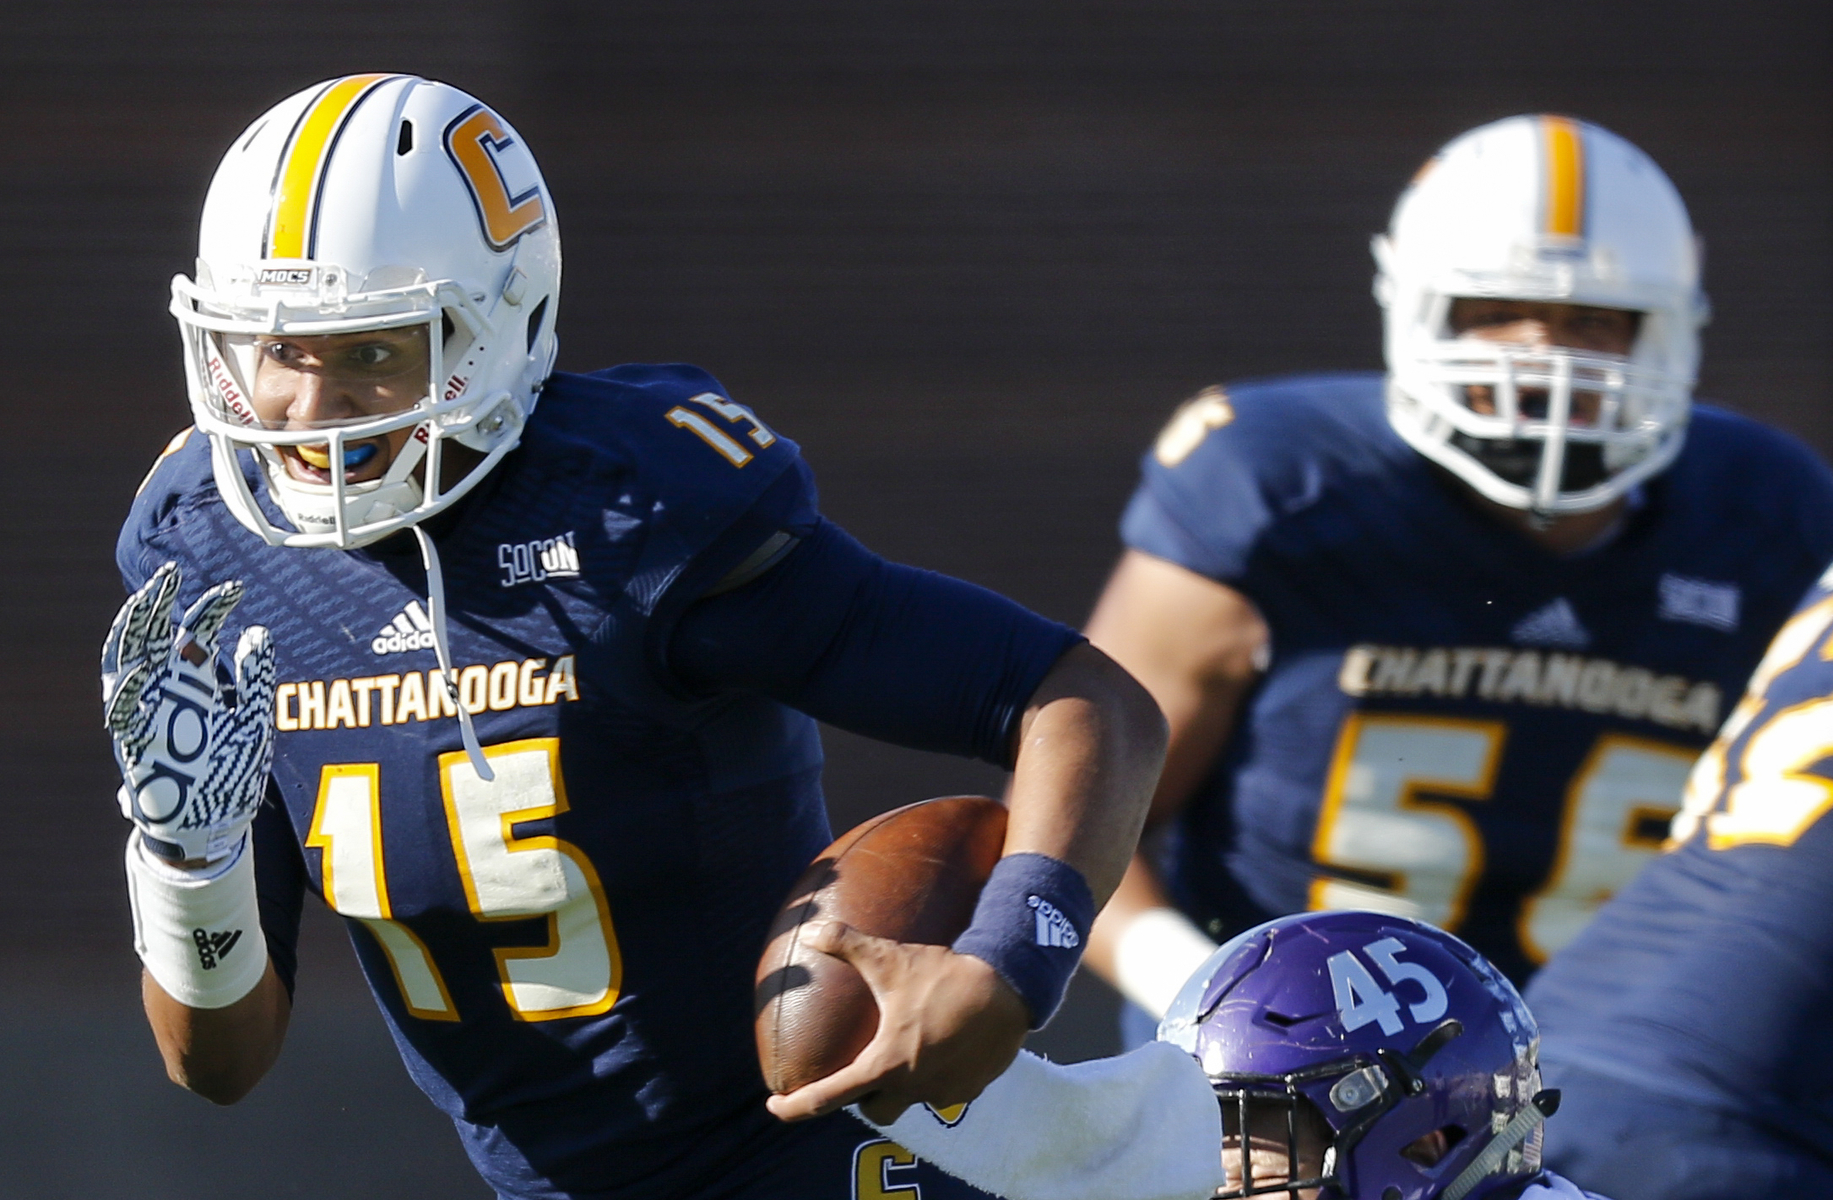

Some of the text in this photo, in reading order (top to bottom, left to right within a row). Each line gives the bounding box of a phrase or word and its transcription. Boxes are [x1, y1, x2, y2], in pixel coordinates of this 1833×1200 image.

[261, 270, 309, 283] MOCS
[208, 356, 255, 426] Riddell
[414, 374, 467, 445] Rell
[664, 392, 776, 469] 15
[371, 631, 436, 655] adida
[275, 654, 579, 732] CHATTANOOGA
[305, 737, 623, 1022] 15
[1026, 895, 1079, 949] adidas
[1326, 936, 1449, 1037] 45
